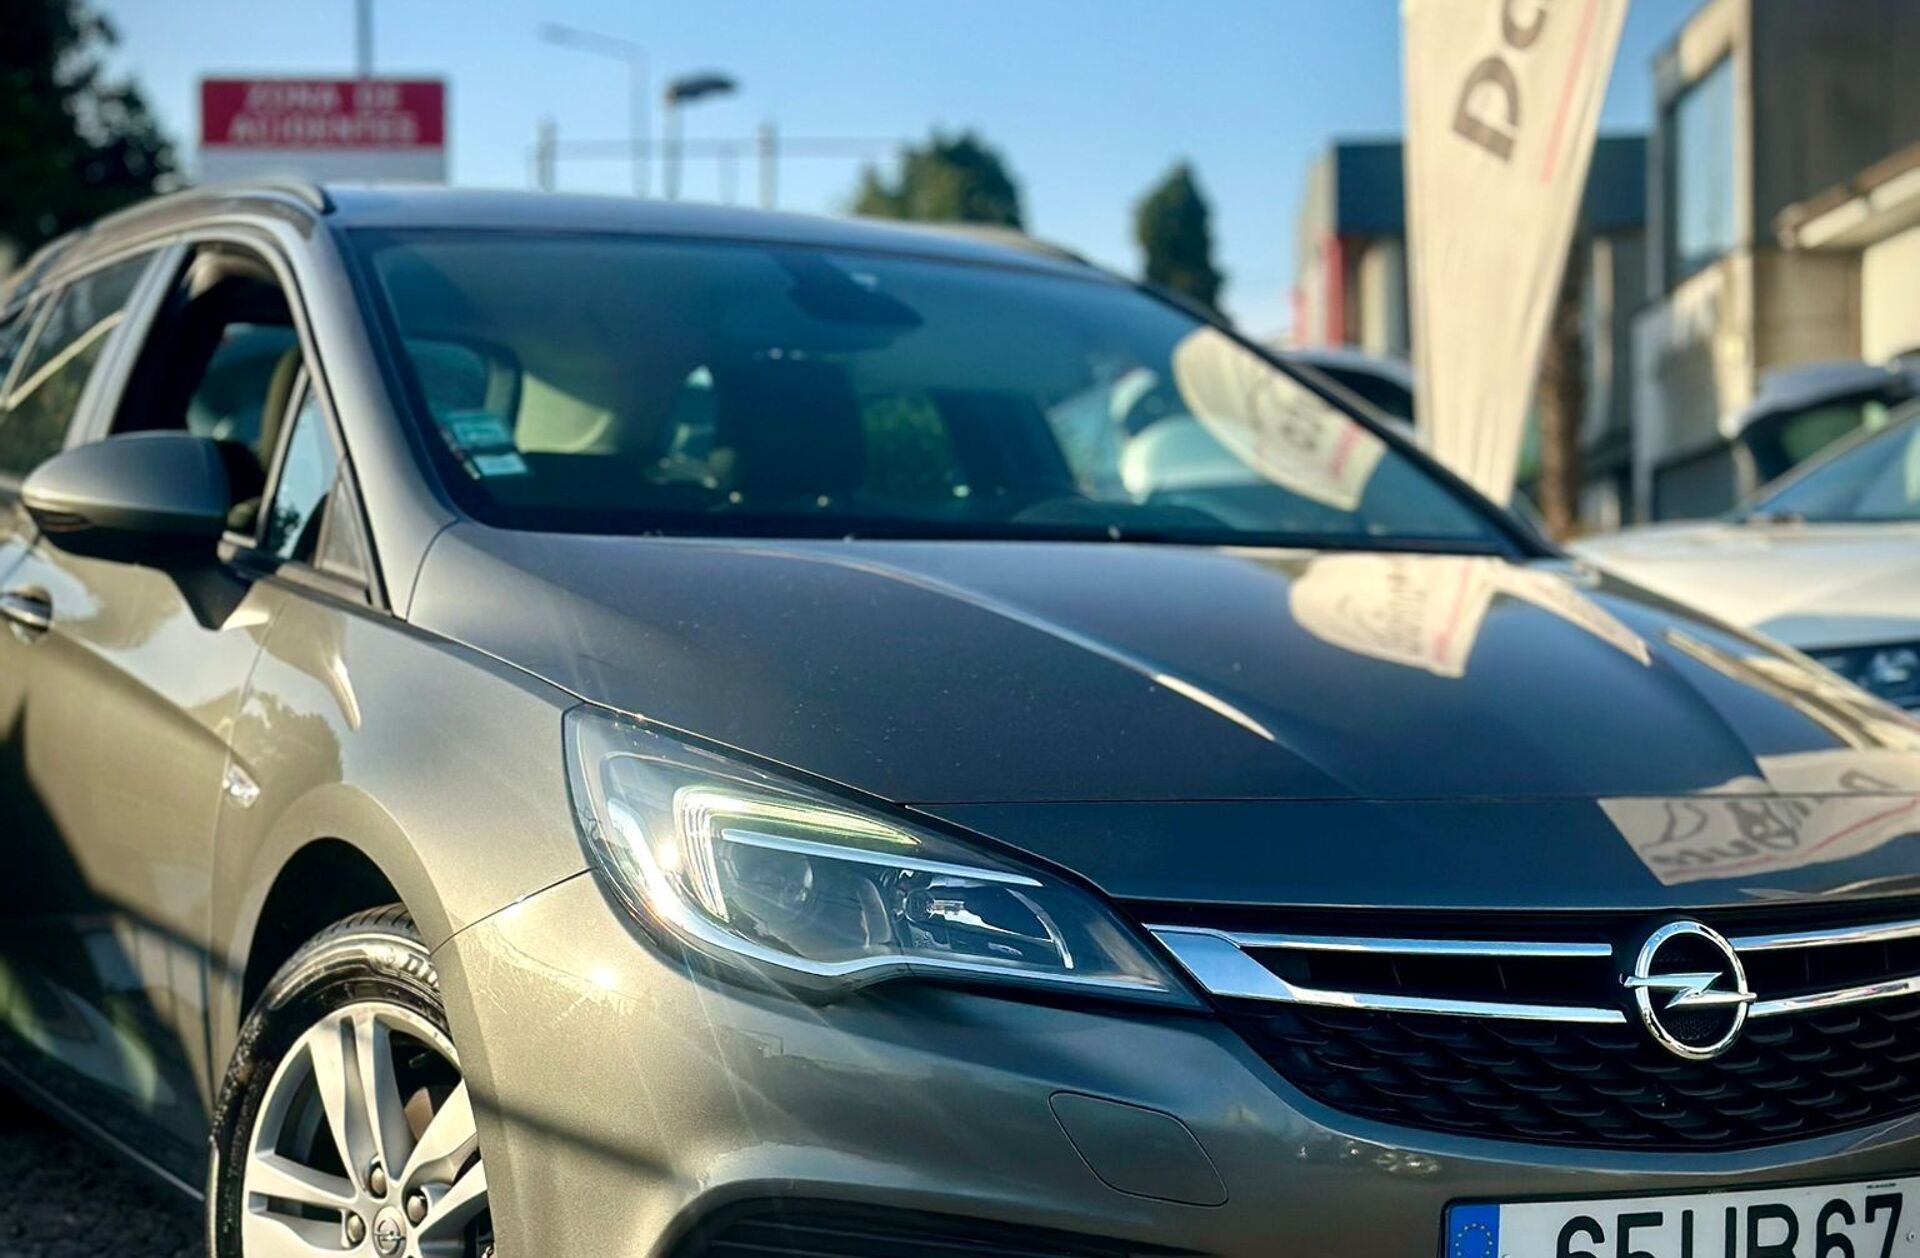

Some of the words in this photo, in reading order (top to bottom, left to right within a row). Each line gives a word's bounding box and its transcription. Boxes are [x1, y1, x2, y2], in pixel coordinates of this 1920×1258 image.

[246, 82, 342, 112] ZONA
[353, 82, 402, 112] DE
[229, 114, 421, 144] ACIDENTES
